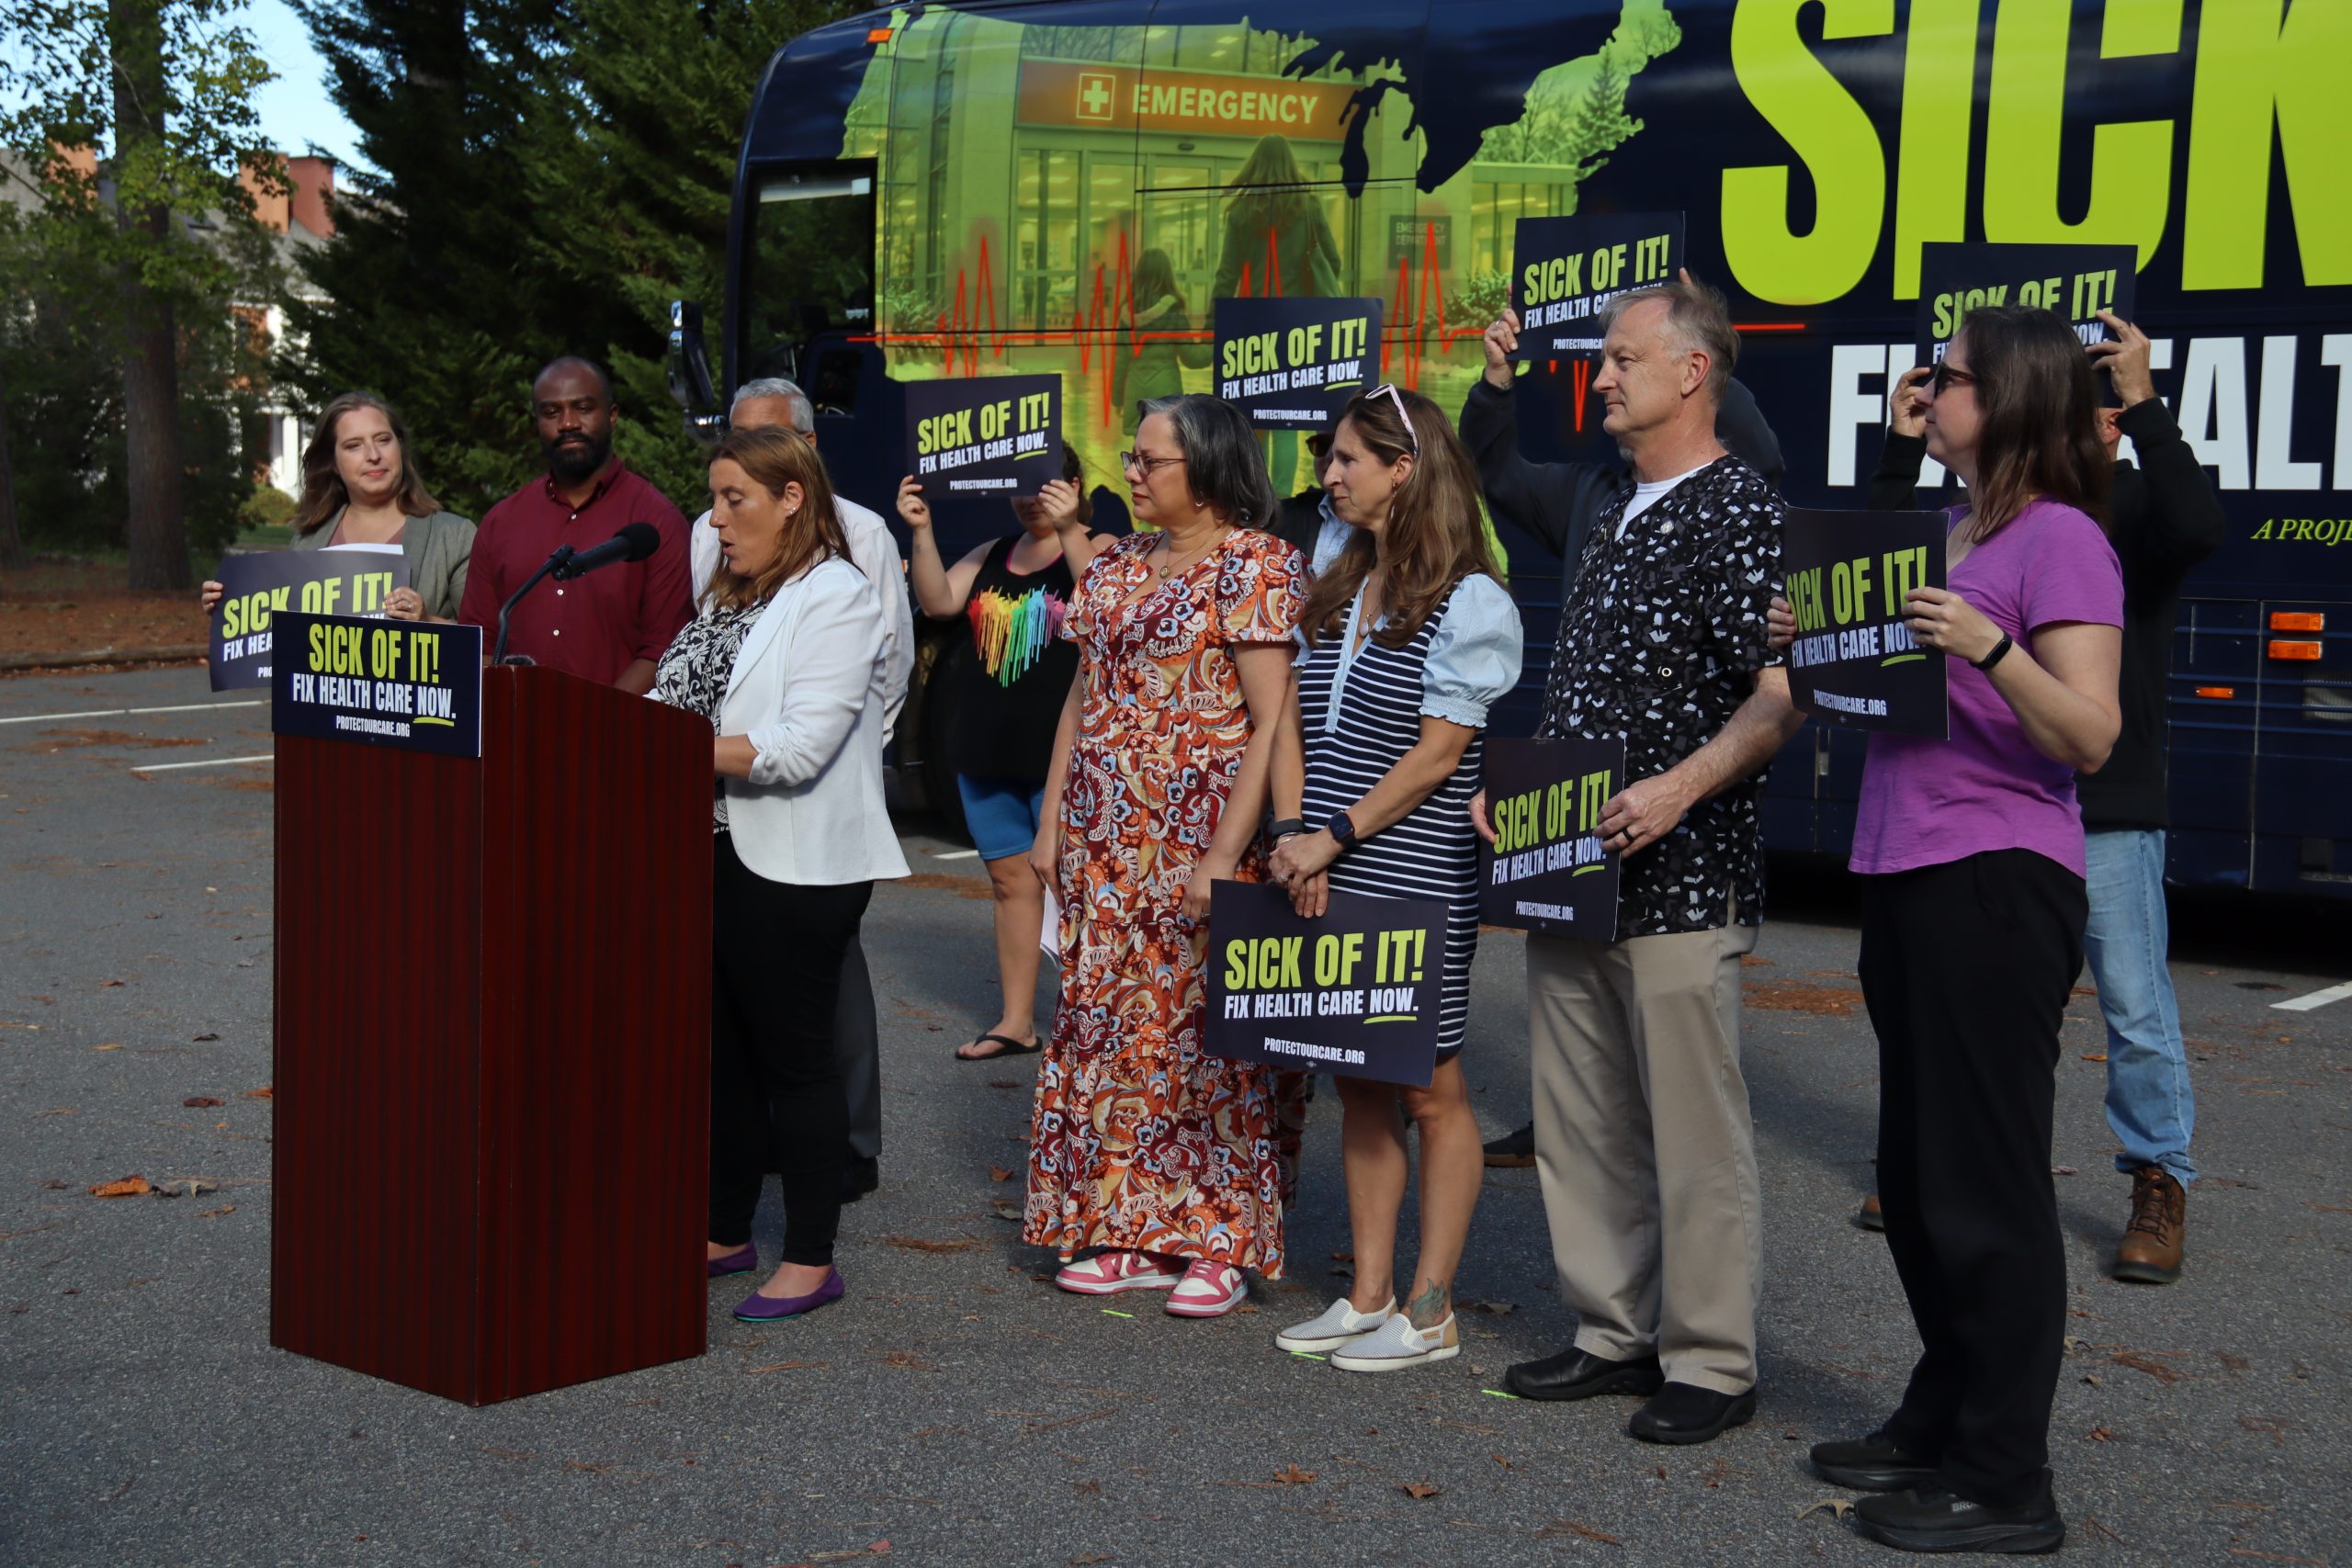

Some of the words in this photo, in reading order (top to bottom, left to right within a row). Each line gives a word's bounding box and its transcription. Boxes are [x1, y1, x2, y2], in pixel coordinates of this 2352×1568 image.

[1132, 84, 1318, 124] EMERGENCY
[1721, 0, 2352, 305] SICK
[1523, 253, 1584, 306] SICK
[1590, 243, 1627, 291] OF
[1634, 234, 1670, 283] IT!
[1524, 307, 1543, 330] FIX
[1545, 297, 1590, 325] HEALTH
[1593, 289, 1627, 314] CA
[2018, 277, 2062, 310] OF
[2071, 269, 2117, 321] IT!
[1222, 332, 1279, 378] SICK
[1287, 323, 1322, 367] OF
[1331, 317, 1367, 361] IT!
[1553, 338, 1603, 350] PROTECTOURCA
[1932, 342, 1950, 365] FI
[1222, 380, 1240, 400] FIX
[1243, 372, 1288, 397] HEALTH
[1291, 366, 1324, 389] CARE
[1328, 360, 1363, 383] NOW.
[917, 408, 973, 455] SICK
[979, 400, 1012, 440] OF
[1019, 391, 1050, 433] IT!
[1253, 409, 1328, 421] PROTECTOURCARE.ORG
[919, 454, 937, 475] FIX
[940, 445, 981, 470] HEALTH
[984, 438, 1013, 460] CARE
[1016, 431, 1048, 453] NOW.
[949, 478, 1018, 491] PROTECTOURCARE.ORG
[2250, 518, 2274, 540] A
[301, 577, 341, 615] OF
[352, 571, 393, 613] IT!
[1786, 567, 1826, 633] SICK
[1831, 557, 1871, 626] OF
[223, 638, 243, 661] FIX
[247, 631, 273, 656] HEA
[309, 623, 364, 675] SICK
[371, 629, 401, 680] OF
[410, 632, 439, 683] IT!
[1792, 639, 1804, 668] FIX
[1804, 634, 1837, 666] HEALTH
[1838, 626, 1880, 661] CARE
[293, 672, 315, 705] FIX
[319, 675, 370, 710] HEALTH
[375, 681, 413, 715] CARE
[417, 686, 457, 719] NOW.
[1813, 688, 1887, 716] PROTECTOURCARE.ORG
[335, 715, 411, 738] PROTECTOURCARE.ORG
[1494, 788, 1542, 854] SICK
[1545, 779, 1574, 840] OF
[1491, 858, 1509, 886] FIX
[1510, 848, 1544, 882] HEALTH
[1546, 840, 1573, 873] CARE
[1515, 900, 1574, 921] PROTECTOURCARE.ORG
[1224, 936, 1304, 990] SICK
[1315, 932, 1364, 987] OF
[1375, 929, 1427, 984] IT!
[1224, 994, 1250, 1020] FIX
[1254, 992, 1313, 1018] HEALTH
[1317, 989, 1363, 1016] CARE
[1369, 987, 1419, 1013] NOW.
[1264, 1036, 1365, 1065] PROTECTOURCARE.ORG
[1952, 1501, 1978, 1513] BRO
